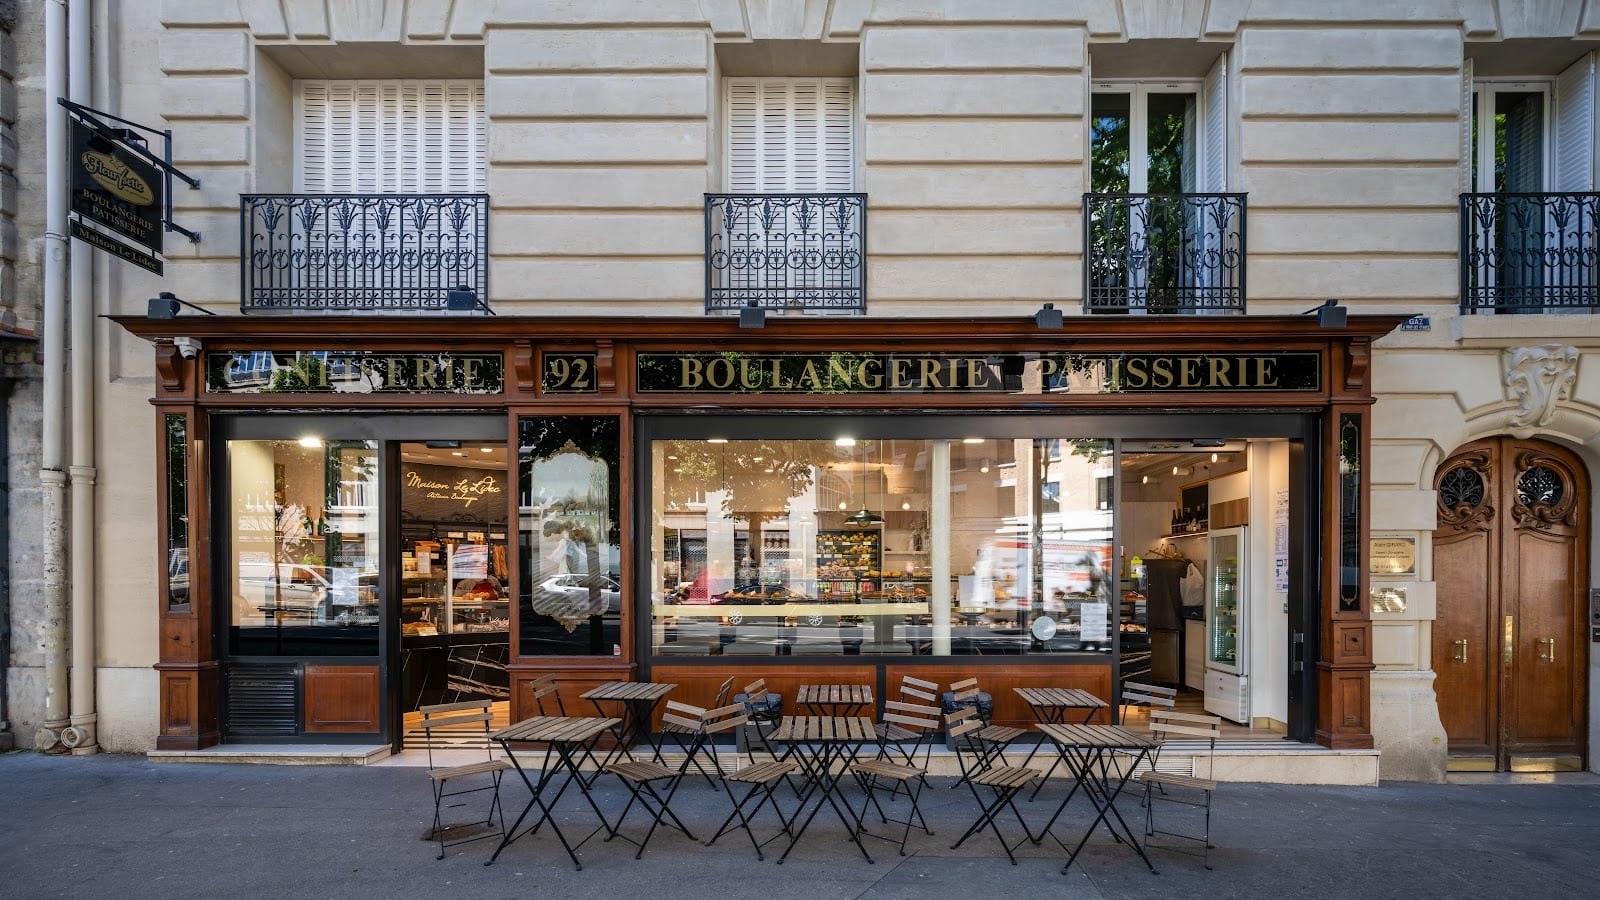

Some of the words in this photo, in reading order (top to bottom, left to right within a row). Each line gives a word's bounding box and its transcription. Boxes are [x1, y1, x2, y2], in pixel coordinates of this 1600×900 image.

[83, 188, 154, 232] BOULANGERIE
[92, 205, 146, 238] PATISSERIE
[79, 227, 116, 251] Maison
[119, 246, 130, 257] Le
[551, 358, 590, 388] 92
[679, 358, 990, 389] BOULANGERIE
[1036, 357, 1279, 388] PATISSERIE
[406, 471, 450, 489] Maison
